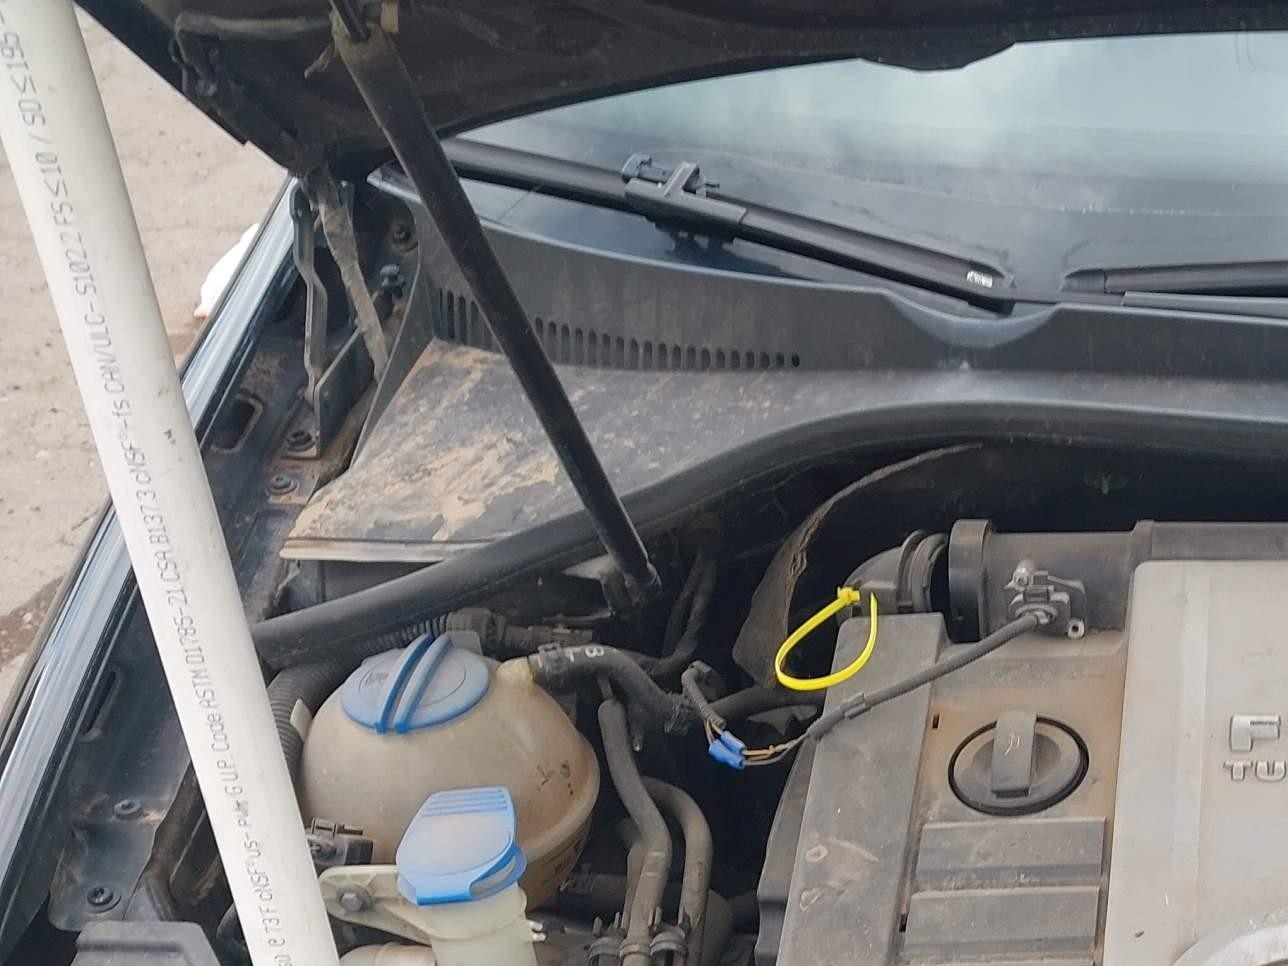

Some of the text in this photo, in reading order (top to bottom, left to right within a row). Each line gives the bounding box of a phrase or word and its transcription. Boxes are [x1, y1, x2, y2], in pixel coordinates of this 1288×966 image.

[154, 549, 180, 581] CSA
[190, 668, 217, 708] ASTM
[206, 713, 229, 751] Code
